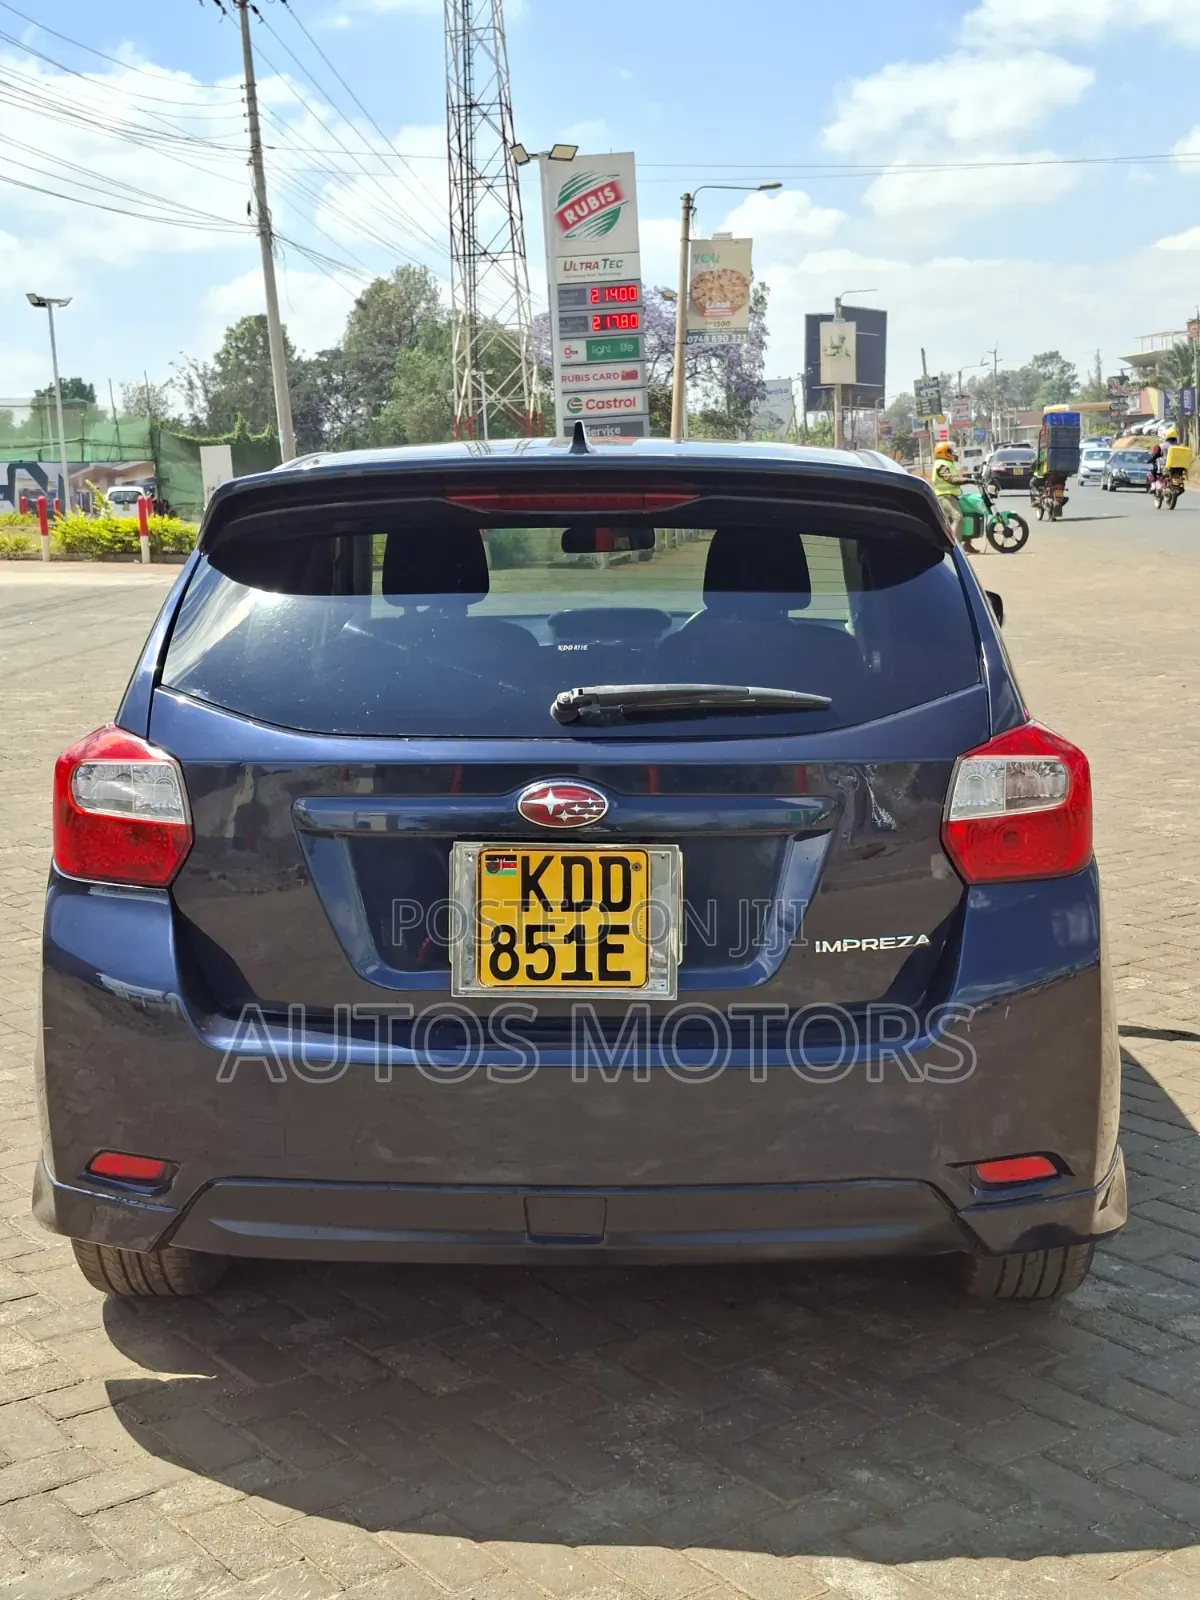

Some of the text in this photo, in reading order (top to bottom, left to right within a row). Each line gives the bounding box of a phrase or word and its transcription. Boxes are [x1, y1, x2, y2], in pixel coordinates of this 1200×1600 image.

[563, 258, 624, 272] ULTRA TEC
[592, 342, 634, 356] light life
[592, 372, 620, 381] CARD
[585, 396, 636, 410] Castrol
[585, 425, 621, 437] Service
[521, 855, 631, 913] KDD
[815, 934, 930, 953] IMPREZA
[488, 924, 631, 981] 851E
